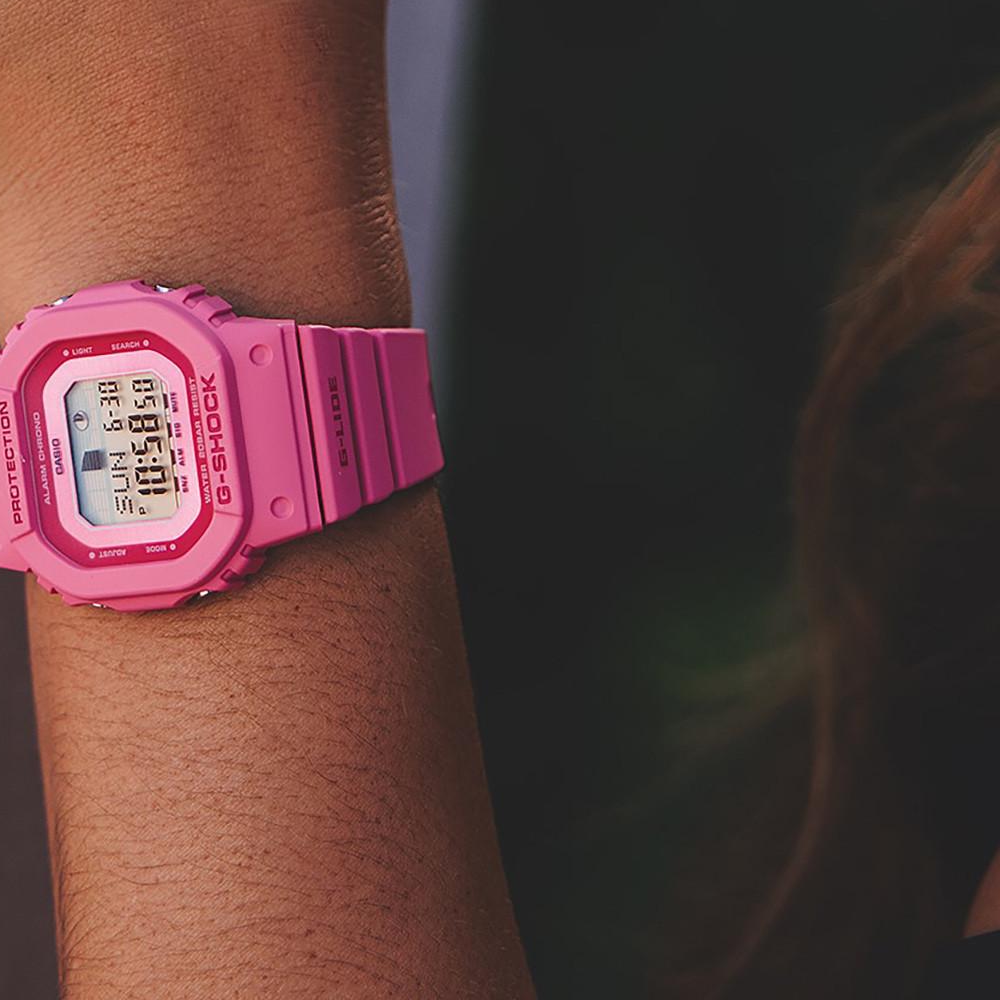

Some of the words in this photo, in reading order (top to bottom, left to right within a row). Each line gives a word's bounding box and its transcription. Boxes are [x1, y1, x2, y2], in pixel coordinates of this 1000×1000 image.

[72, 347, 93, 356] LIGHT
[111, 341, 140, 351] SEARCH
[98, 381, 123, 431] 6-30
[170, 392, 179, 413] MUTE
[187, 376, 201, 417] RESIST
[33, 411, 46, 461] CHRONO
[193, 421, 207, 459] 20BAR
[200, 372, 232, 505] G-SHOCK
[327, 375, 349, 467] G-LIDE
[51, 438, 65, 475] CASIO
[128, 414, 168, 496] 10:58
[176, 449, 186, 467] ALM
[40, 464, 51, 505] ALARM
[109, 451, 134, 514] SUN
[200, 464, 212, 504] WATER
[98, 548, 127, 558] ADJUST
[145, 545, 168, 554] MODE
